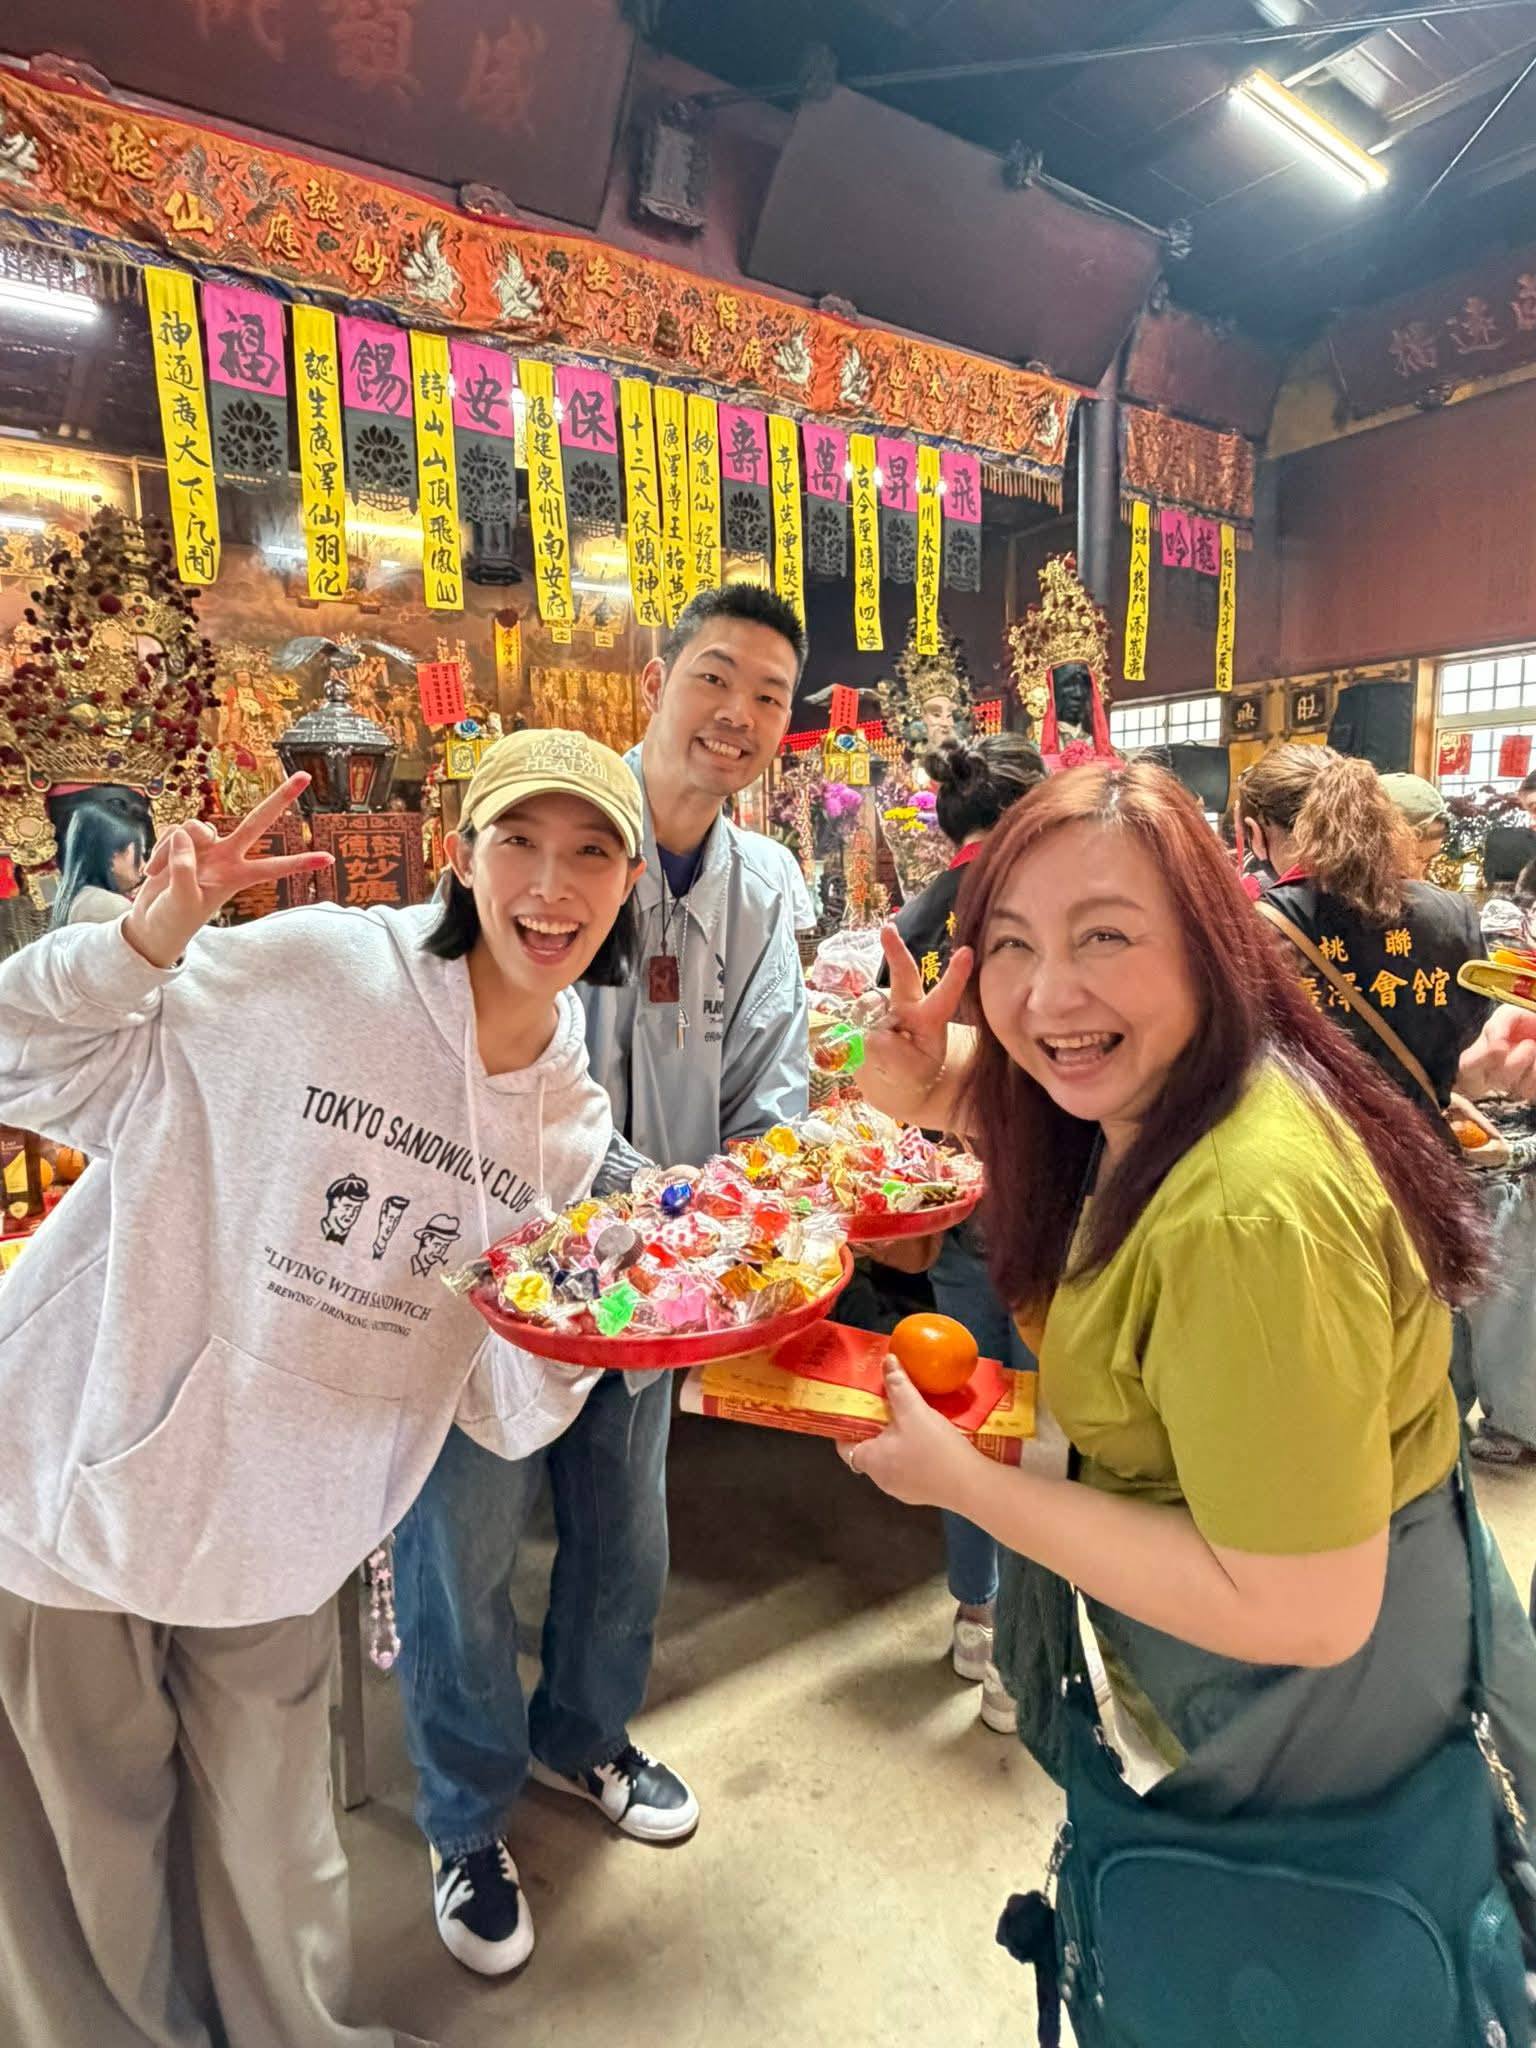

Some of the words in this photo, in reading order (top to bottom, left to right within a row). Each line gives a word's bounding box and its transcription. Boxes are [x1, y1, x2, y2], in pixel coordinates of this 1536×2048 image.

[219, 309, 280, 388] 福
[459, 363, 509, 431] 安
[564, 388, 616, 446] 保
[726, 416, 763, 481] 壽
[810, 437, 842, 500] 萬
[528, 396, 567, 620] 福建泉州南安府
[951, 467, 977, 517] 飛
[302, 1085, 385, 1139] TOKYO
[384, 1116, 492, 1185] SANDWICH
[490, 1168, 536, 1213] CLUB
[267, 1280, 314, 1306] BREWING
[328, 1276, 370, 1306] WITH
